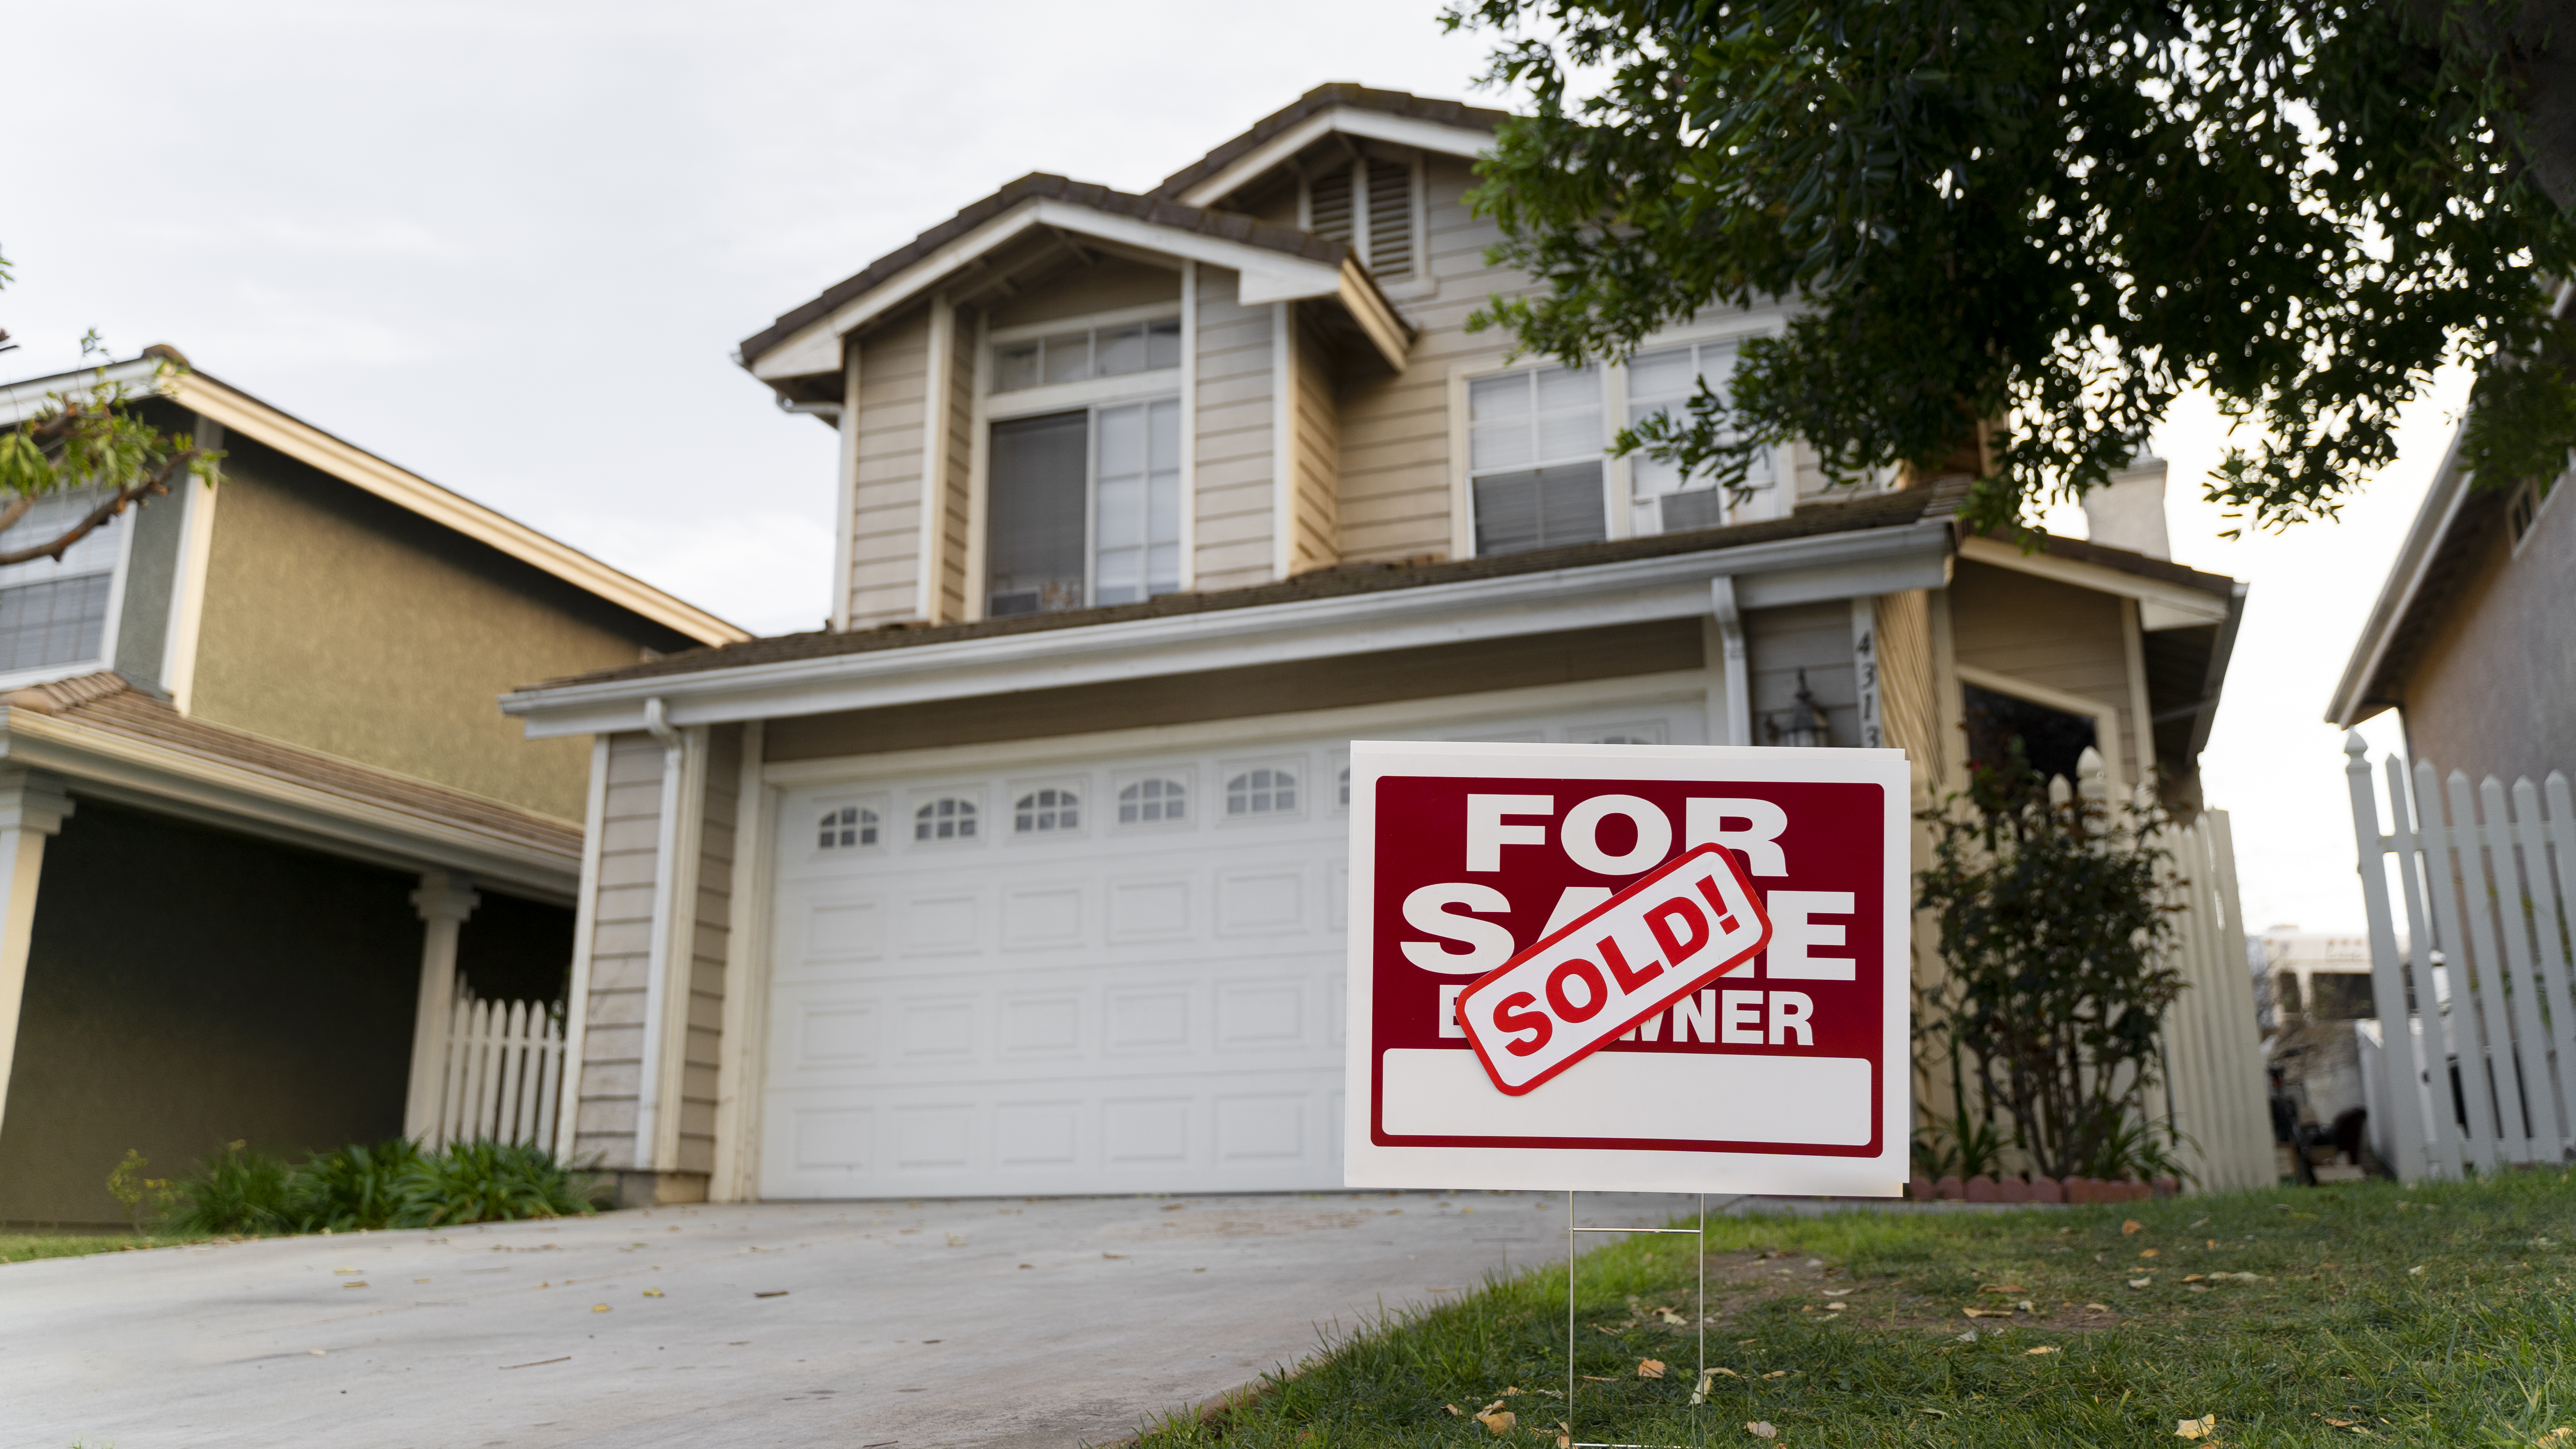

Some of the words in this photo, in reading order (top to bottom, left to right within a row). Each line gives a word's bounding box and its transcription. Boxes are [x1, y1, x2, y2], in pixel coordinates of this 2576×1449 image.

[1466, 793, 1789, 877] FOR
[1493, 874, 1740, 1057] SOLD!
[1619, 989, 1814, 1046] NER
